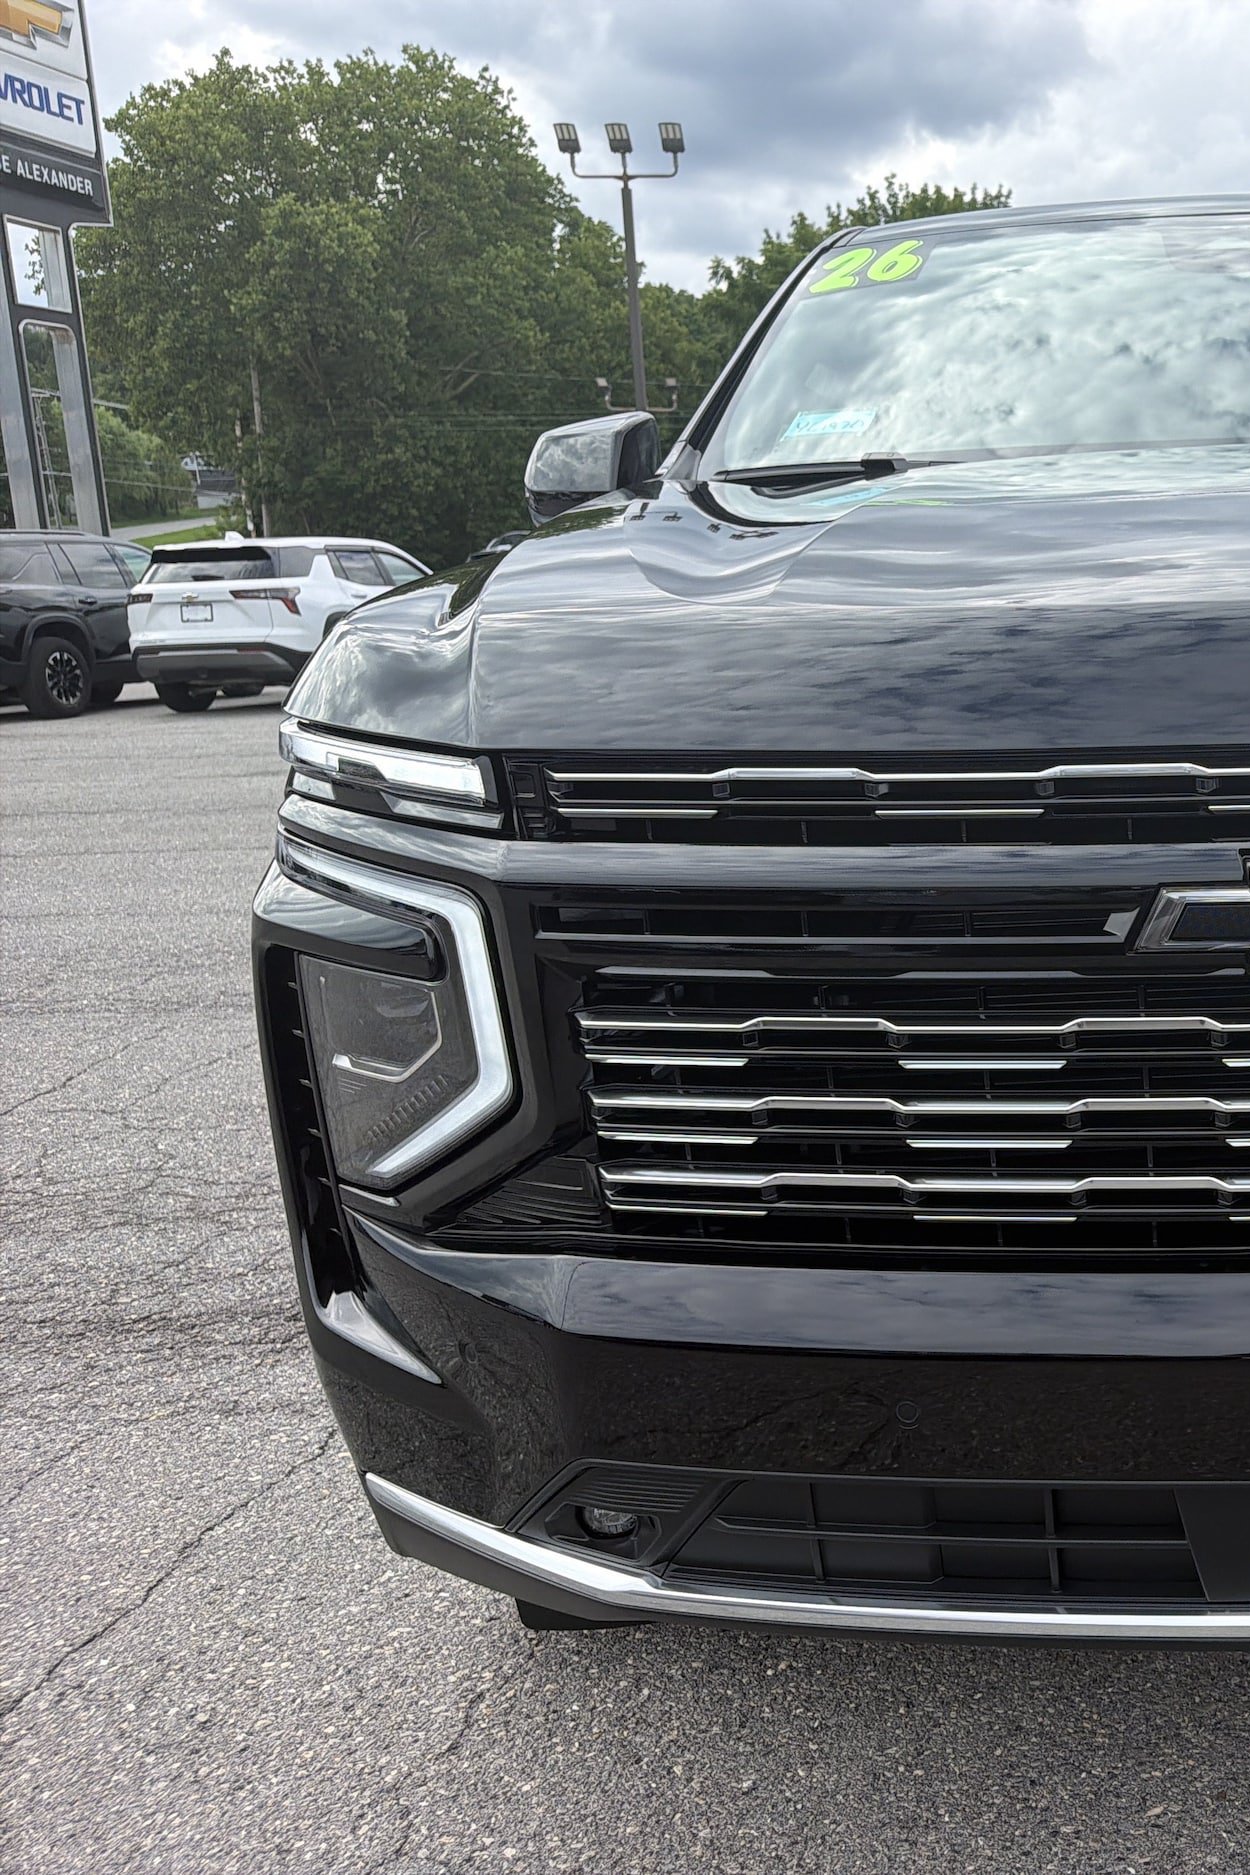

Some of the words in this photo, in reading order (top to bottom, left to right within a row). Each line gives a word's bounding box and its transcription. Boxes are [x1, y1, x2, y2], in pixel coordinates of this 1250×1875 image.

[0, 154, 12, 174] E
[16, 159, 94, 197] ALEXANDER
[809, 239, 924, 293] 26
